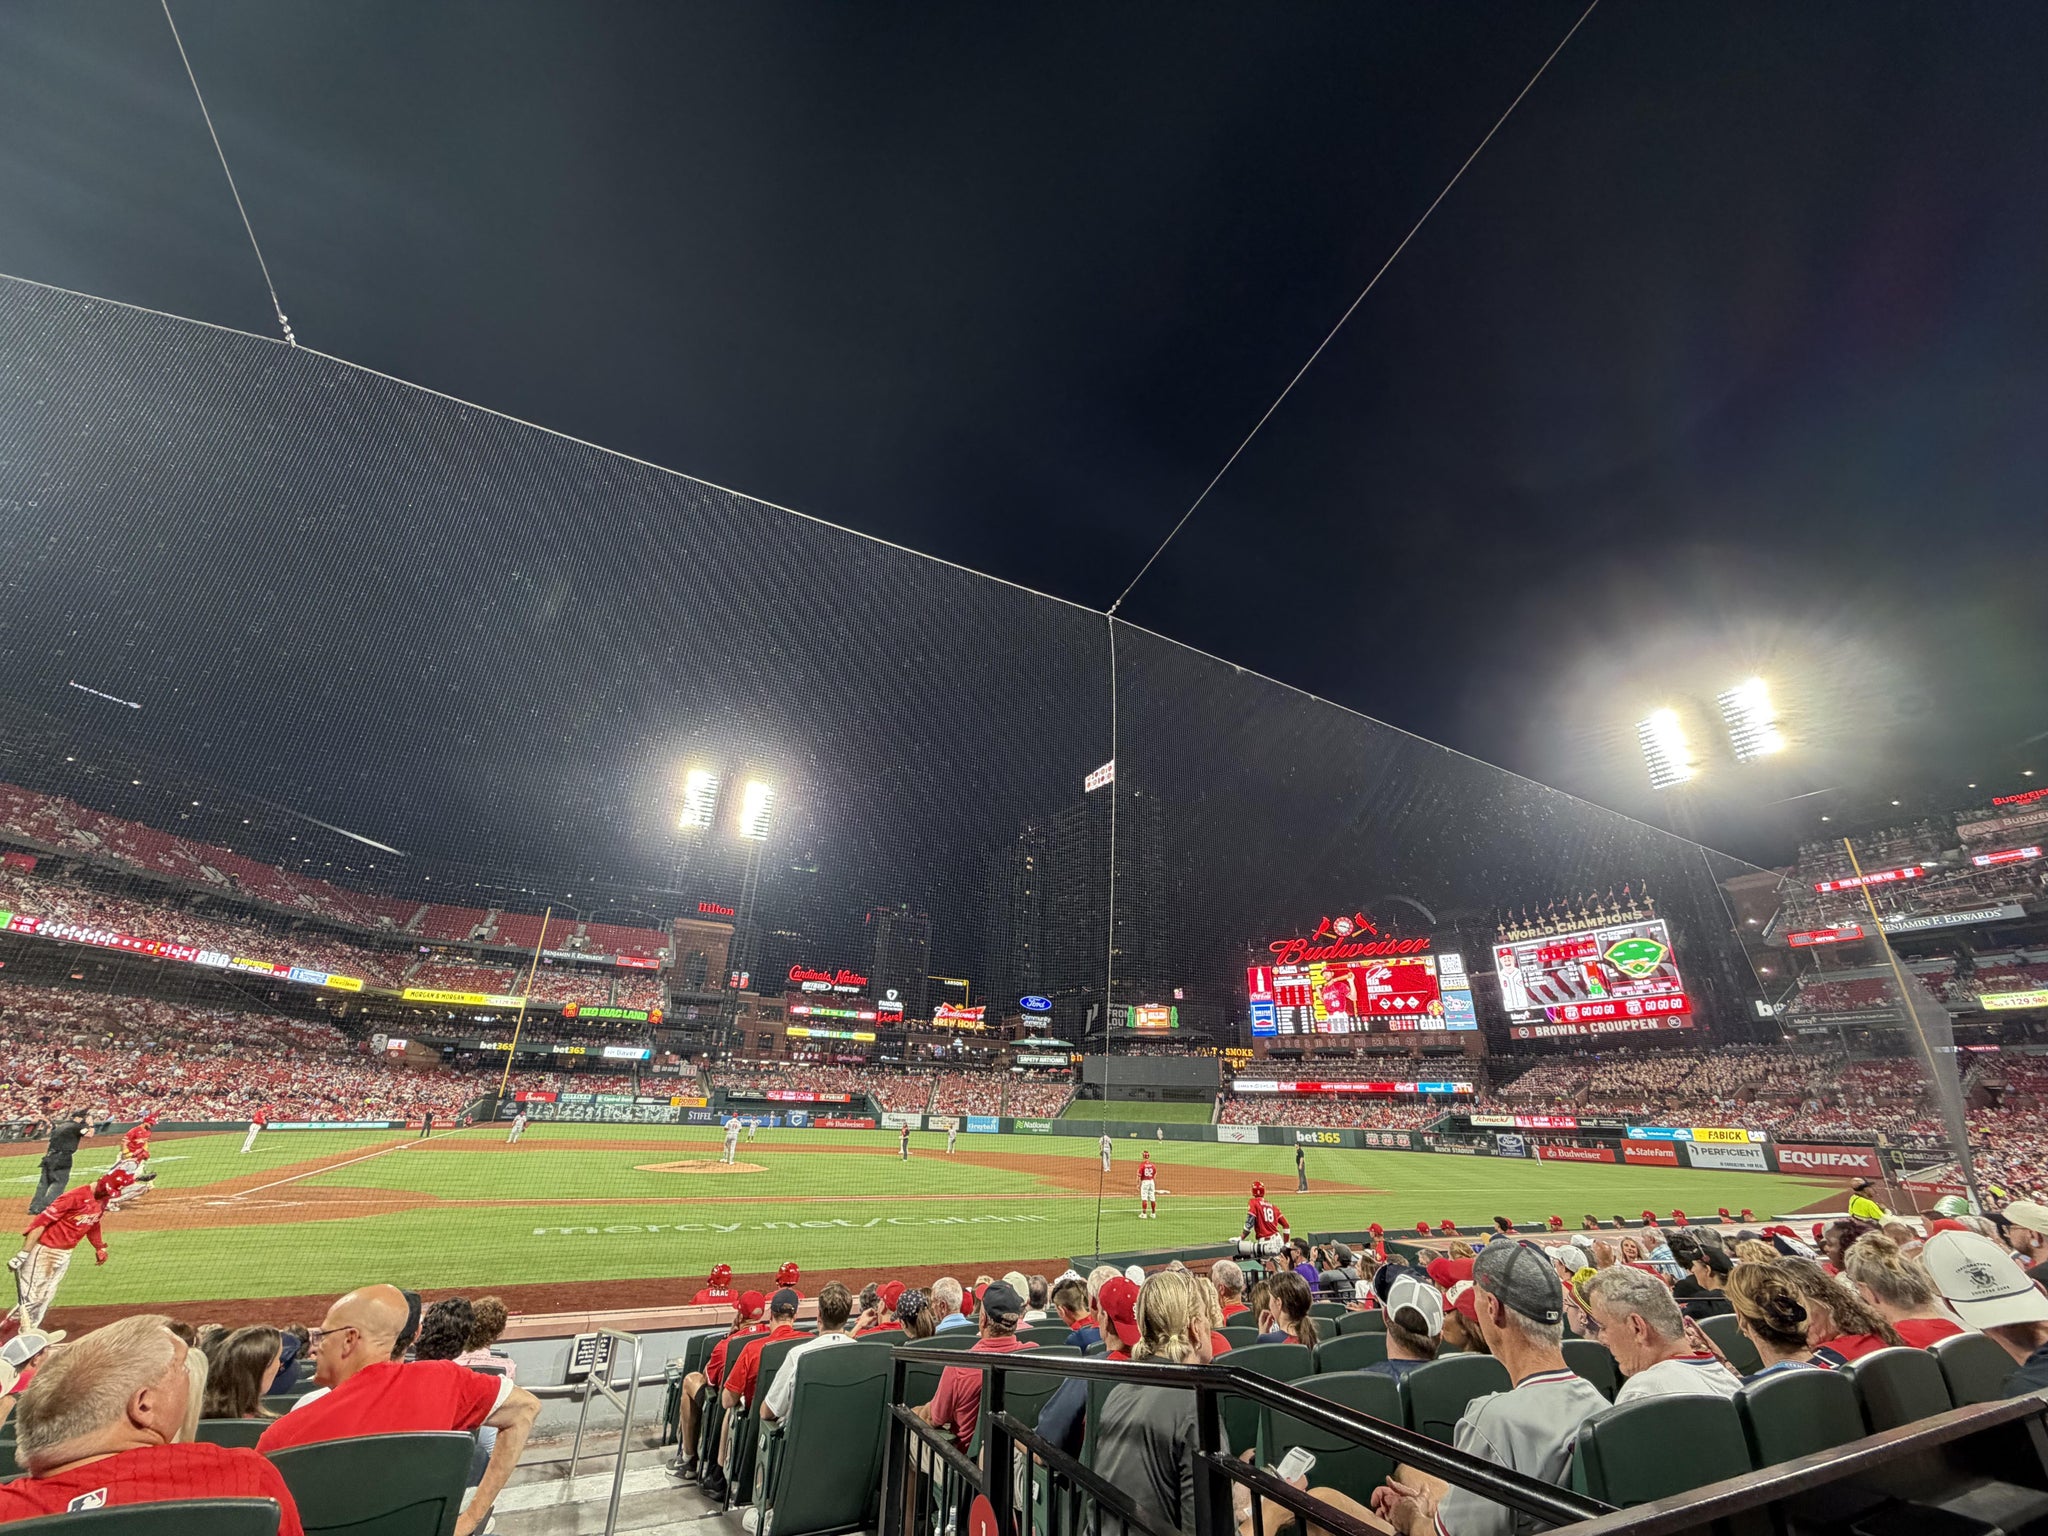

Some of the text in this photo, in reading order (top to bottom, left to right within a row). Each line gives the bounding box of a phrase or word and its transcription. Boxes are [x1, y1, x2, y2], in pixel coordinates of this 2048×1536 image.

[698, 902, 735, 916] Hilton
[1944, 910, 2001, 924] EDWARDS
[1507, 911, 1643, 942] WORLD CHAMPIONS
[1269, 933, 1431, 966] Budweiser
[789, 964, 868, 986] Cardinals Nation
[1027, 998, 1046, 1008] Ford
[1645, 1001, 1656, 1011] GO
[1658, 1000, 1669, 1010] GO
[1671, 999, 1682, 1009] GO
[1582, 1007, 1591, 1016] GO
[1593, 1006, 1602, 1015] GO
[1604, 1005, 1614, 1014] GO
[877, 1011, 903, 1023] Live!
[933, 1017, 956, 1027] BREW
[1021, 1014, 1051, 1024] Community
[1535, 1023, 1577, 1037] BROWN
[1589, 1018, 1658, 1033] CROUPPEN
[480, 1041, 514, 1051] bet365
[552, 1045, 586, 1055] bet365
[1225, 1048, 1253, 1058] SMOKE
[688, 1110, 712, 1121] STIFEL
[1474, 1116, 1510, 1124] Schnucks
[834, 1120, 865, 1129] Budweiser
[1023, 1121, 1051, 1130] National
[1296, 1130, 1341, 1145] bet365
[1501, 1136, 1518, 1145] Ford
[1708, 1131, 1742, 1141] FABICK
[1748, 1131, 1767, 1142] CAT
[1558, 1149, 1601, 1160] Budweiser
[1700, 1147, 1760, 1158] PERFICIENT
[1778, 1149, 1870, 1168] EQUIFAX
[1263, 1207, 1275, 1223] 18
[709, 1289, 729, 1297] ISAAC
